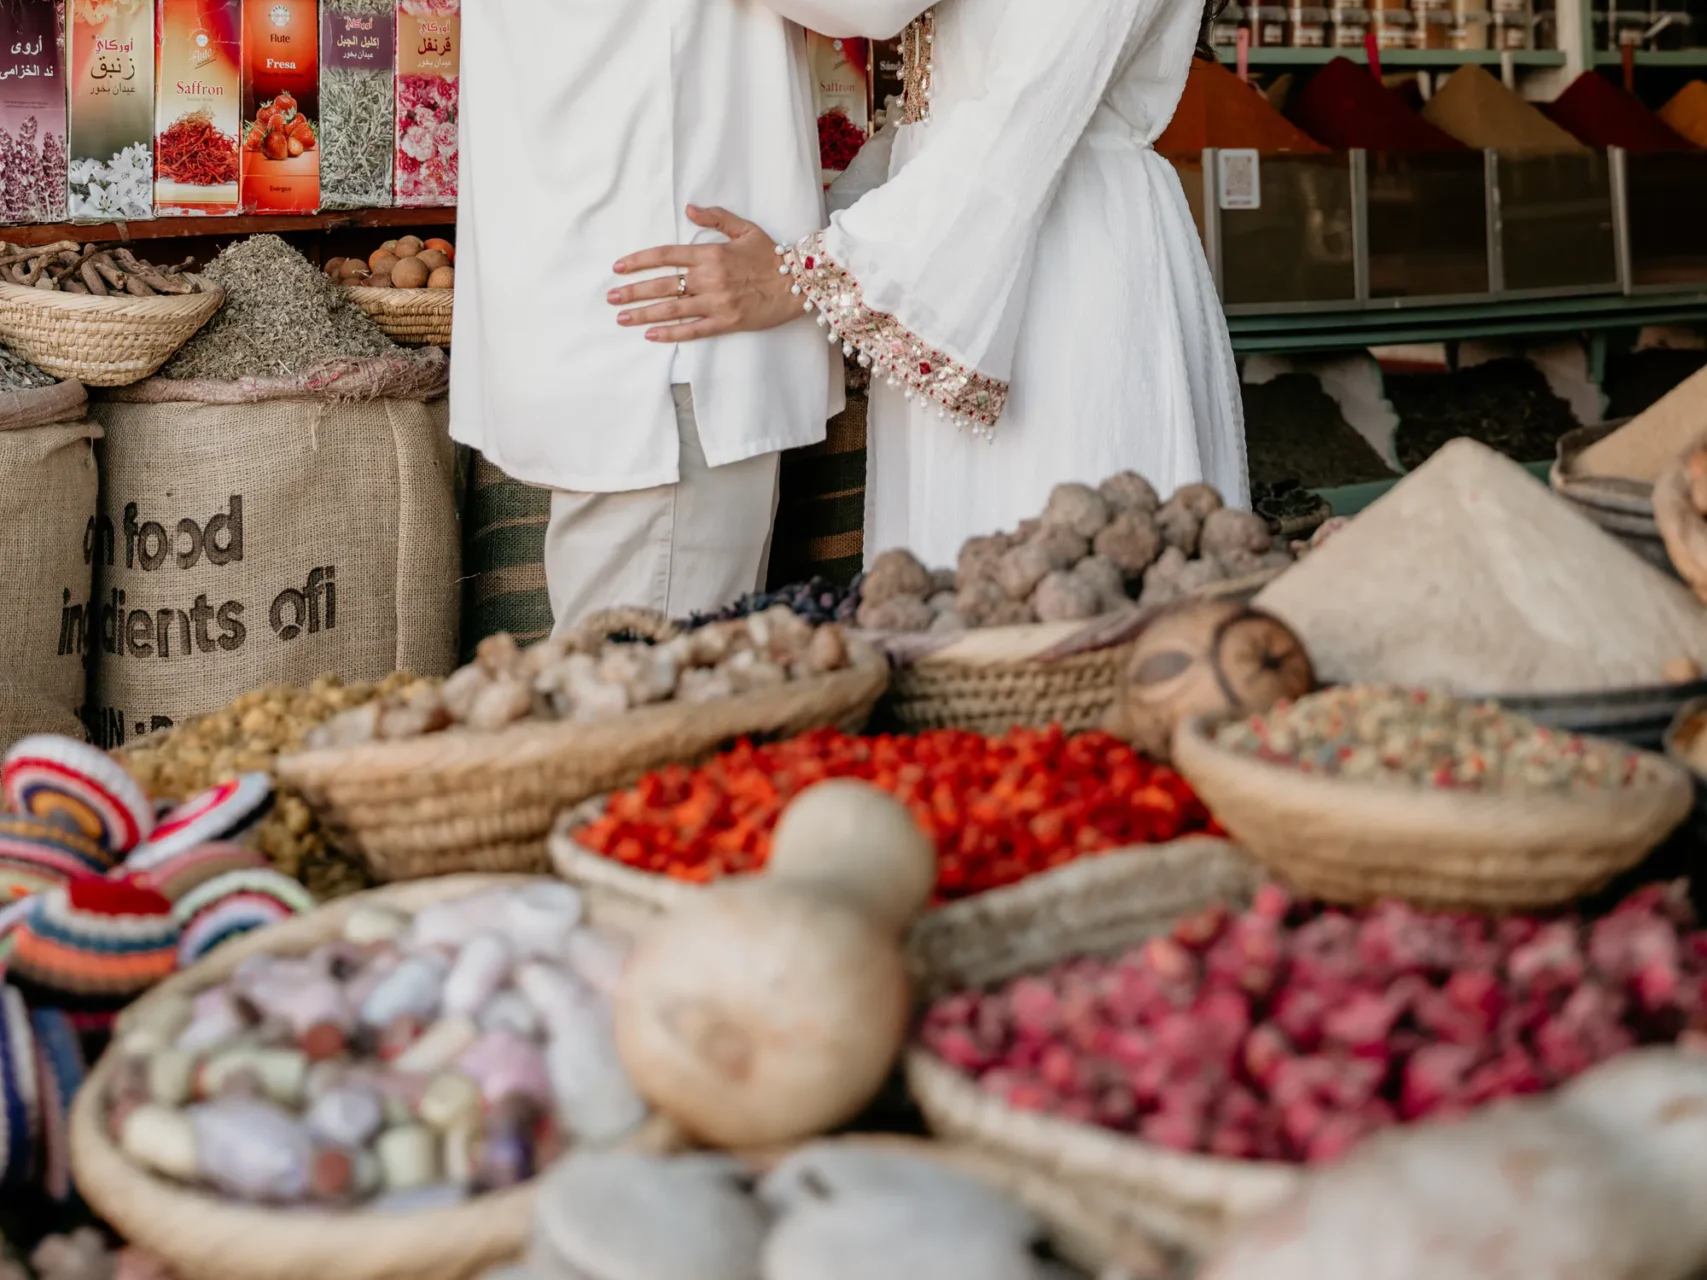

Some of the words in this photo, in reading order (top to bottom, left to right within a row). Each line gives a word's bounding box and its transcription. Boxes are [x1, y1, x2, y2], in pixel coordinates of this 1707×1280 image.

[270, 33, 290, 43] Flute
[337, 35, 358, 48] الجبل
[360, 35, 380, 49] إكليل
[11, 35, 42, 55] أروى
[418, 35, 451, 56] قرنفل
[90, 56, 135, 80] زنبق
[266, 58, 296, 70] Fresa
[44, 65, 54, 77] ند
[90, 84, 111, 95] بخور
[113, 84, 136, 95] عيدان
[177, 80, 224, 96] Saffron
[820, 81, 855, 92] Saffron
[123, 495, 243, 571] food
